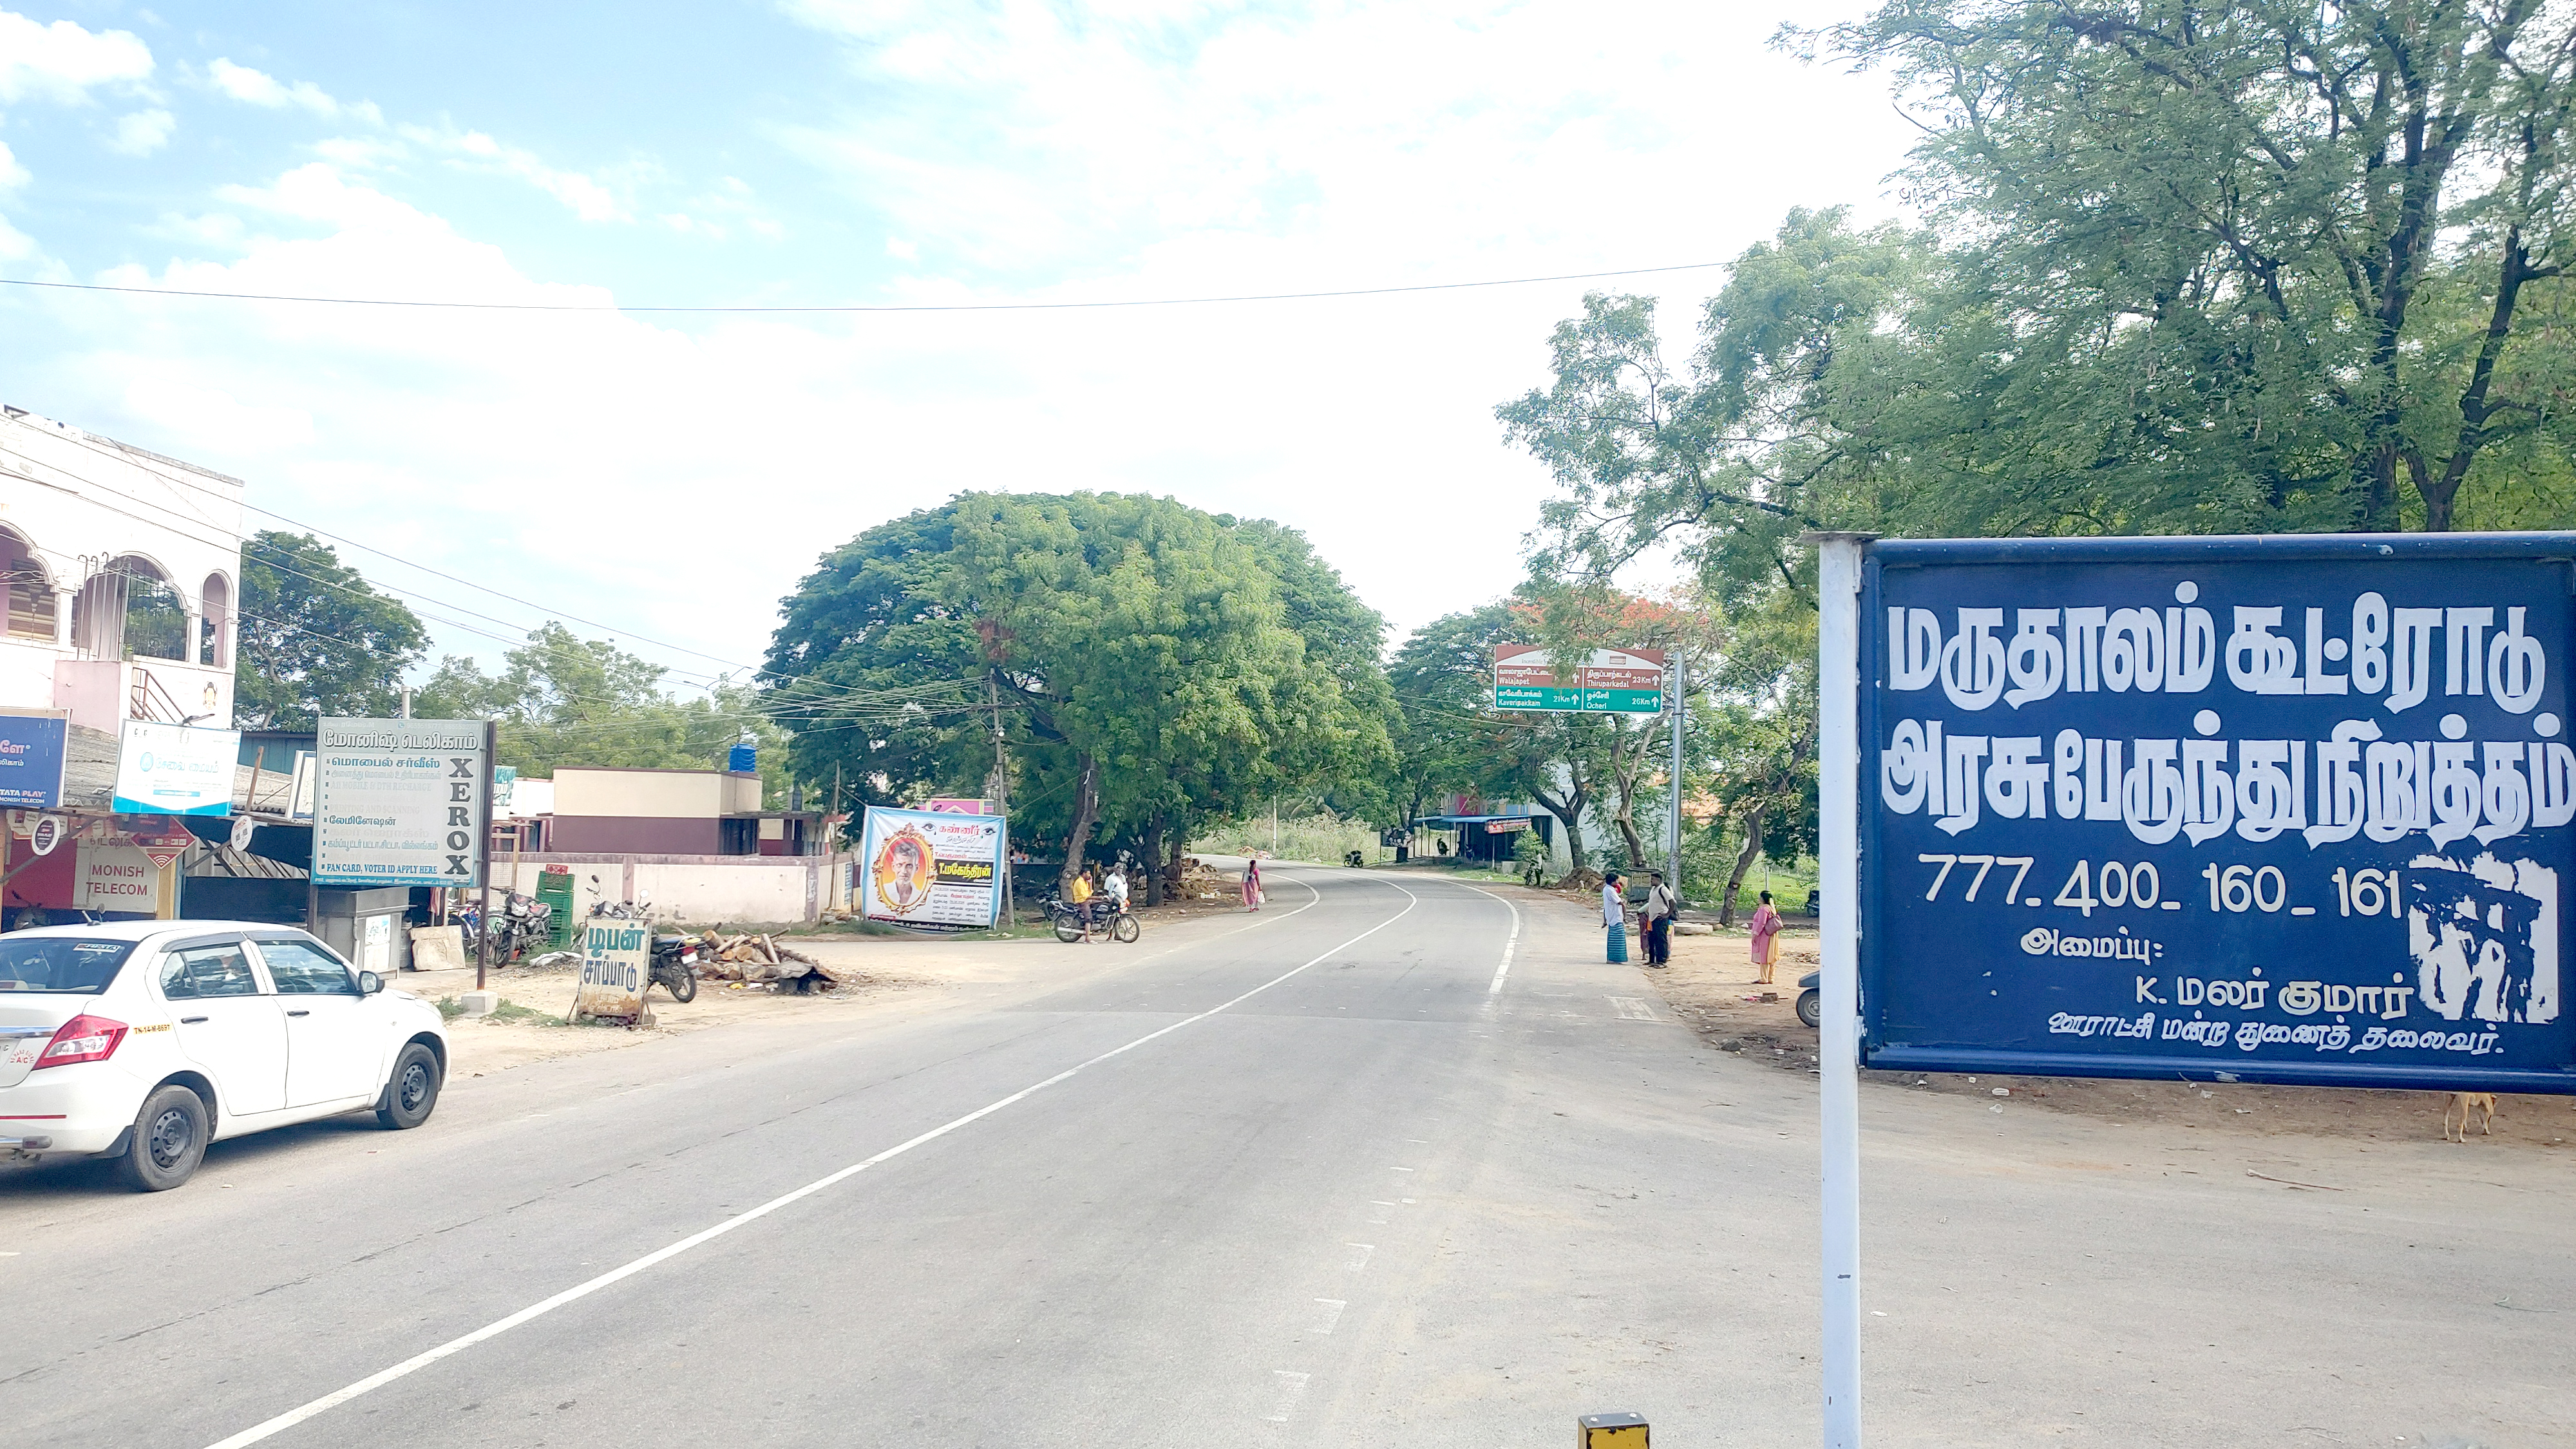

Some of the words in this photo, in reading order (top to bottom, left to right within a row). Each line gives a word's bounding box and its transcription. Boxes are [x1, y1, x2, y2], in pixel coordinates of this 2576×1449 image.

[1887, 581, 2216, 711] மருதாலம்
[1587, 679, 1629, 688] Thiruparkadal
[322, 728, 399, 752] மோனிஷ்
[402, 732, 478, 751] டெலிகாம்
[331, 757, 393, 768] மொபைல்
[396, 756, 440, 768] சர்வீஸ்
[329, 815, 397, 828] லேமினேஷன்
[444, 757, 475, 875] XEROX
[91, 864, 145, 878] MONISH
[327, 863, 341, 872] PAN
[342, 864, 363, 875] CARD,
[365, 864, 386, 873] VOTER
[387, 865, 395, 873] ID
[396, 865, 419, 874] APPLY
[419, 865, 438, 874] HERE
[86, 882, 148, 896] TELECOM
[2331, 866, 2402, 920] 161
[2020, 925, 2164, 966] அமைப்பு:
[583, 954, 637, 992] சாப்பாடு
[2136, 975, 2168, 1005] K.
[2177, 967, 2270, 1010] மலர்
[2278, 971, 2415, 1021] குமார்
[2048, 1012, 2155, 1041] ஊராட்சி
[2161, 1010, 2231, 1047] மன்ற
[2348, 1023, 2505, 1054] தலைவர்.
